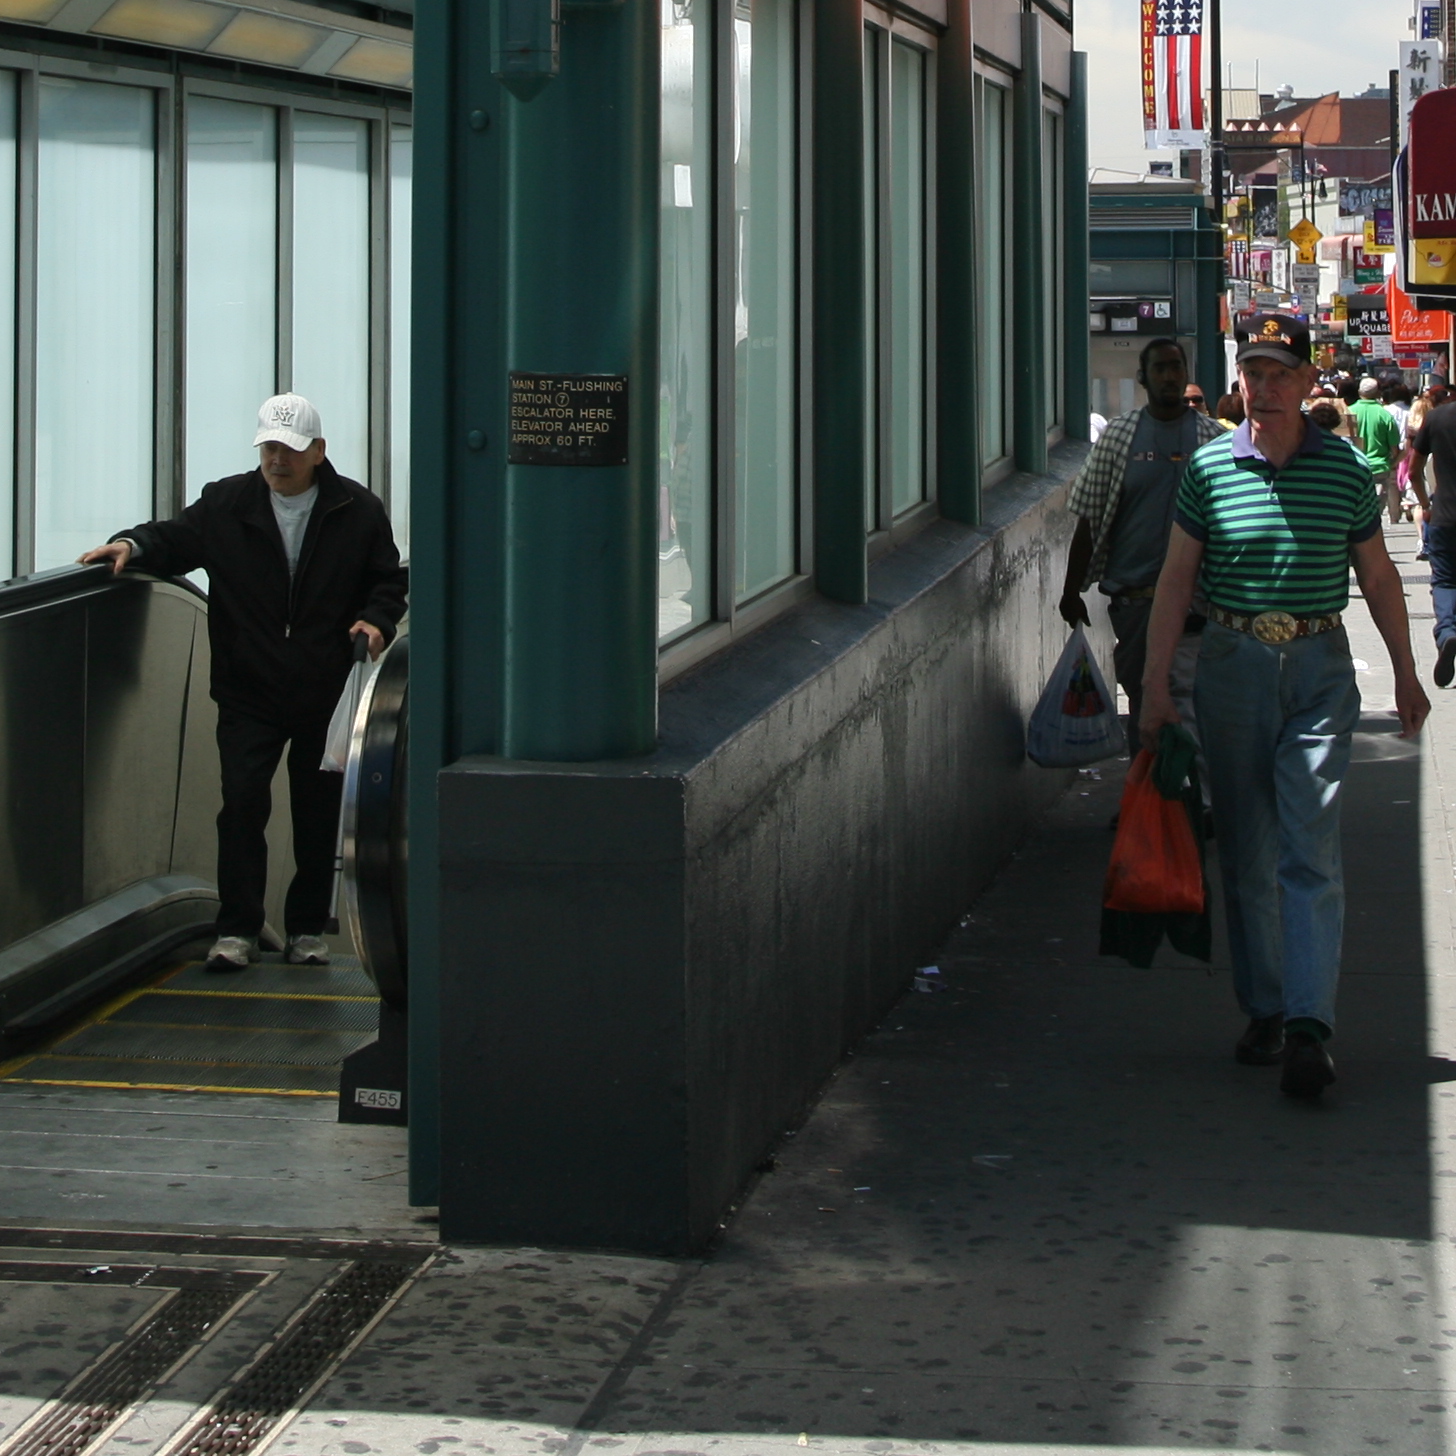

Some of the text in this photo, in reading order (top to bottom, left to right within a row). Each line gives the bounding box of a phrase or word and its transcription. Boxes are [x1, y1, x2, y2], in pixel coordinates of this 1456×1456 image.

[1142, 3, 1155, 114] WELCOME
[1143, 305, 1150, 315] 7
[1349, 318, 1361, 326] UP
[1359, 323, 1391, 335] SQUARE
[512, 380, 535, 390] MAIN
[512, 393, 552, 404] STATION
[511, 406, 574, 418] ESCALATOR
[511, 420, 610, 433] ELEVATOR AHEAD
[512, 433, 596, 446] APPROX 60 FT.
[357, 1090, 398, 1107] E455
